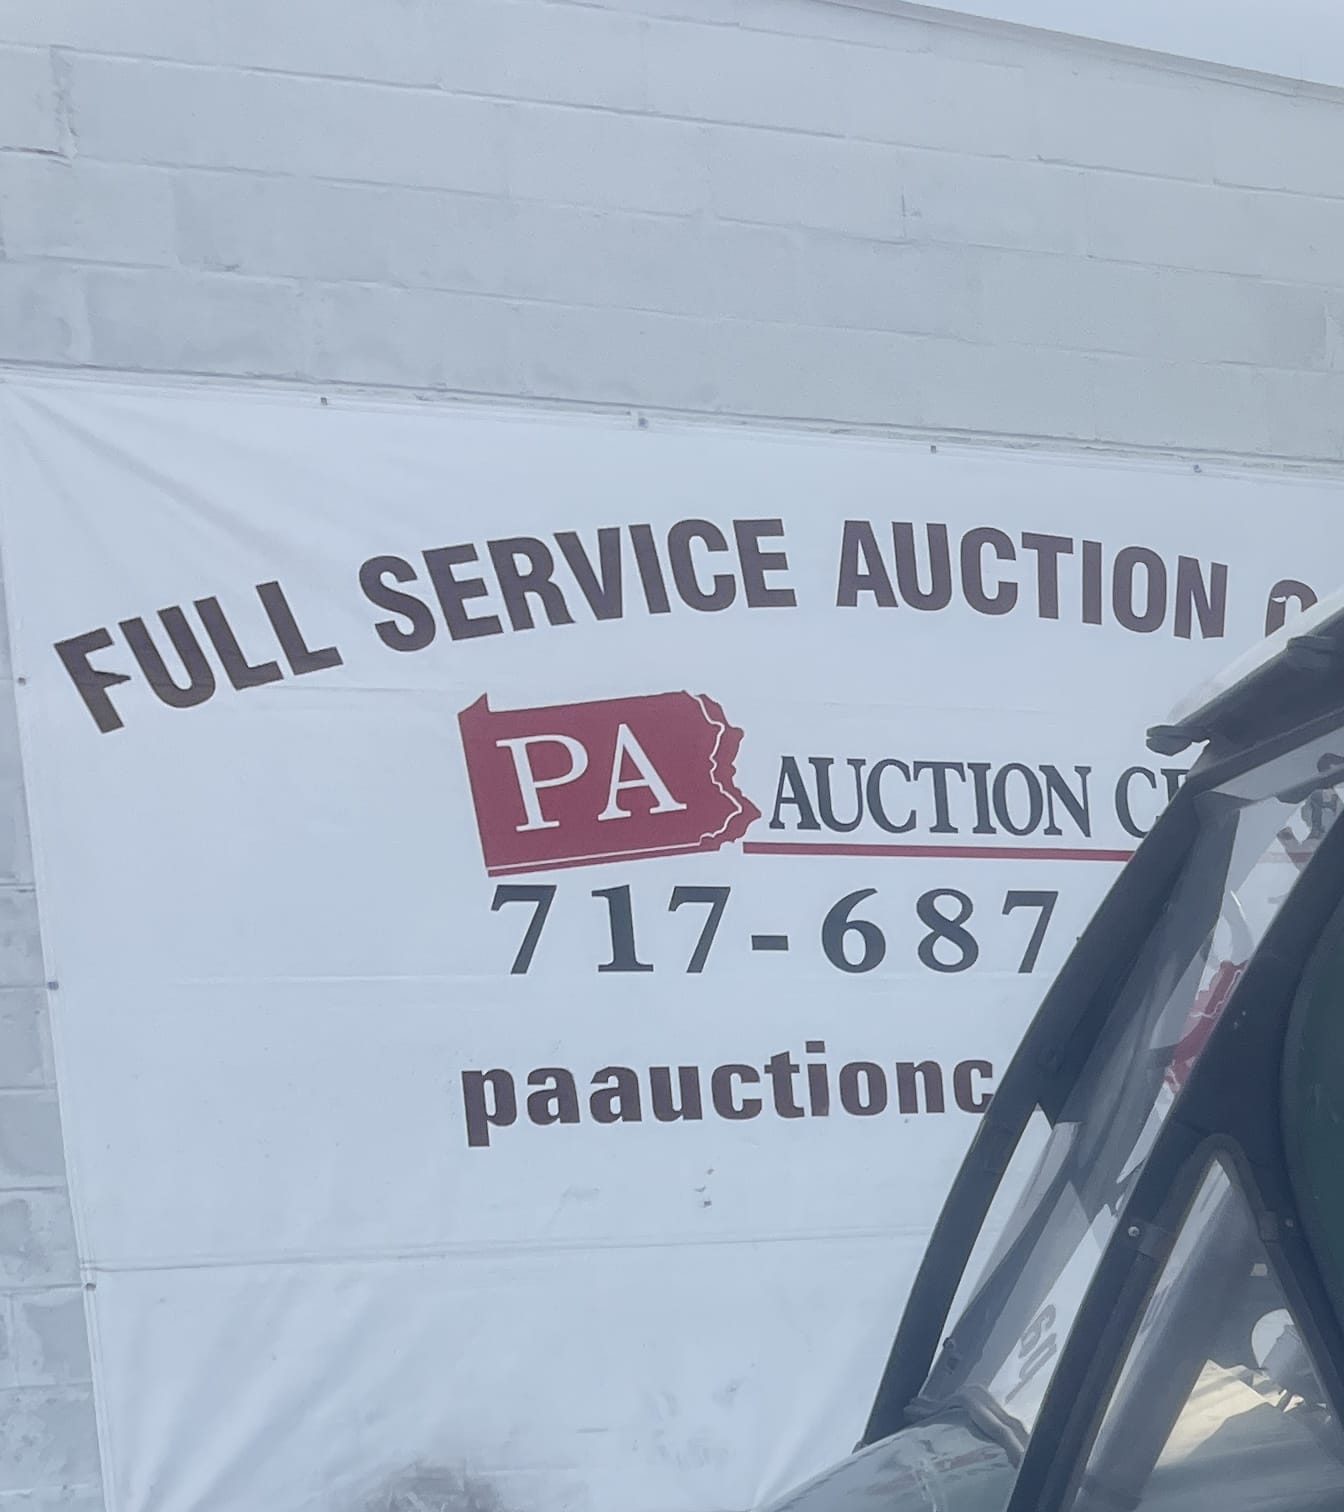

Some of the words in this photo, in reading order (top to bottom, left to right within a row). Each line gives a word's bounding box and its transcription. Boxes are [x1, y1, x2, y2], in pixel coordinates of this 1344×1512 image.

[54, 580, 343, 734] FULL
[358, 518, 798, 652] SERVICE
[836, 519, 1229, 640] AUCTION
[496, 722, 687, 834] PA
[769, 755, 1092, 839] AUCTION
[490, 883, 1083, 975] 717-687
